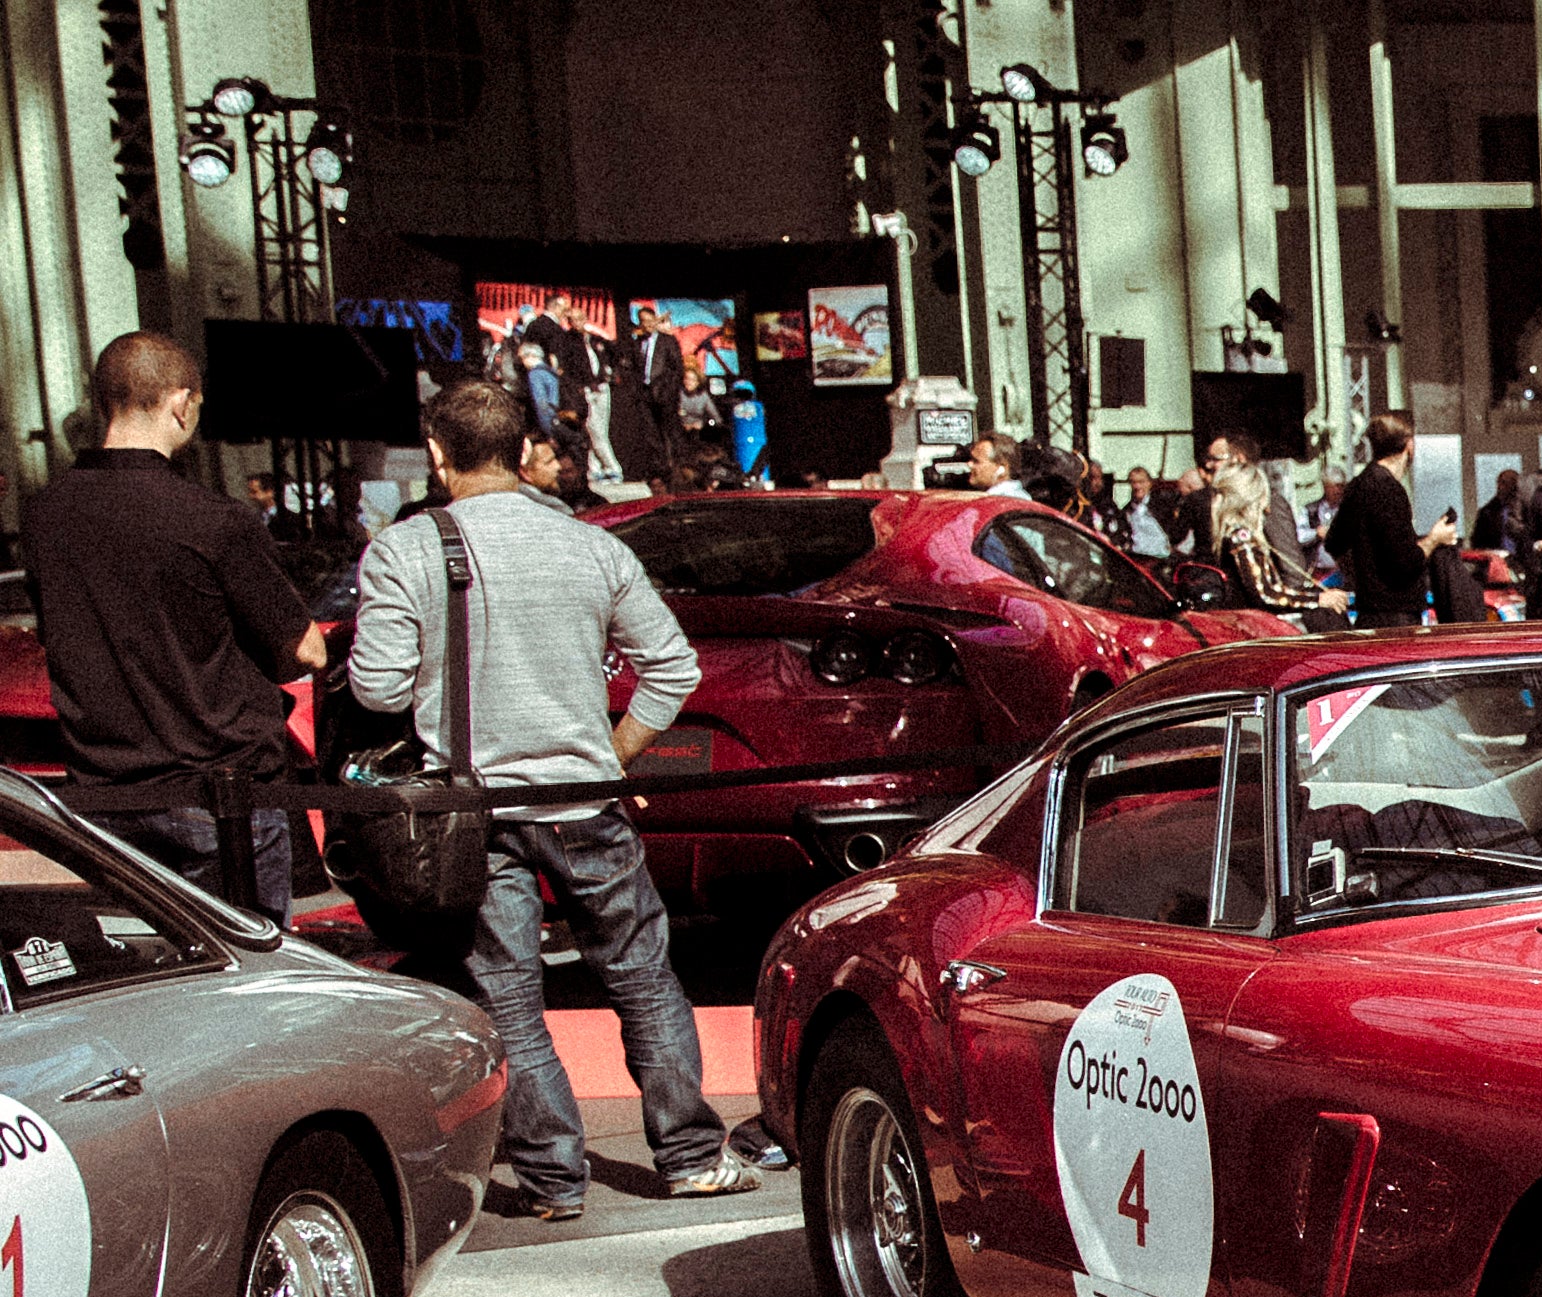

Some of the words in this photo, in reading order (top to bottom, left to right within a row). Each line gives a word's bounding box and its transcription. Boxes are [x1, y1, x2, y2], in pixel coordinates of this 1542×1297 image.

[1316, 699, 1335, 726] 1
[1067, 1040, 1128, 1110] Optic
[1135, 1057, 1197, 1123] 2000
[1117, 1148, 1150, 1248] 4
